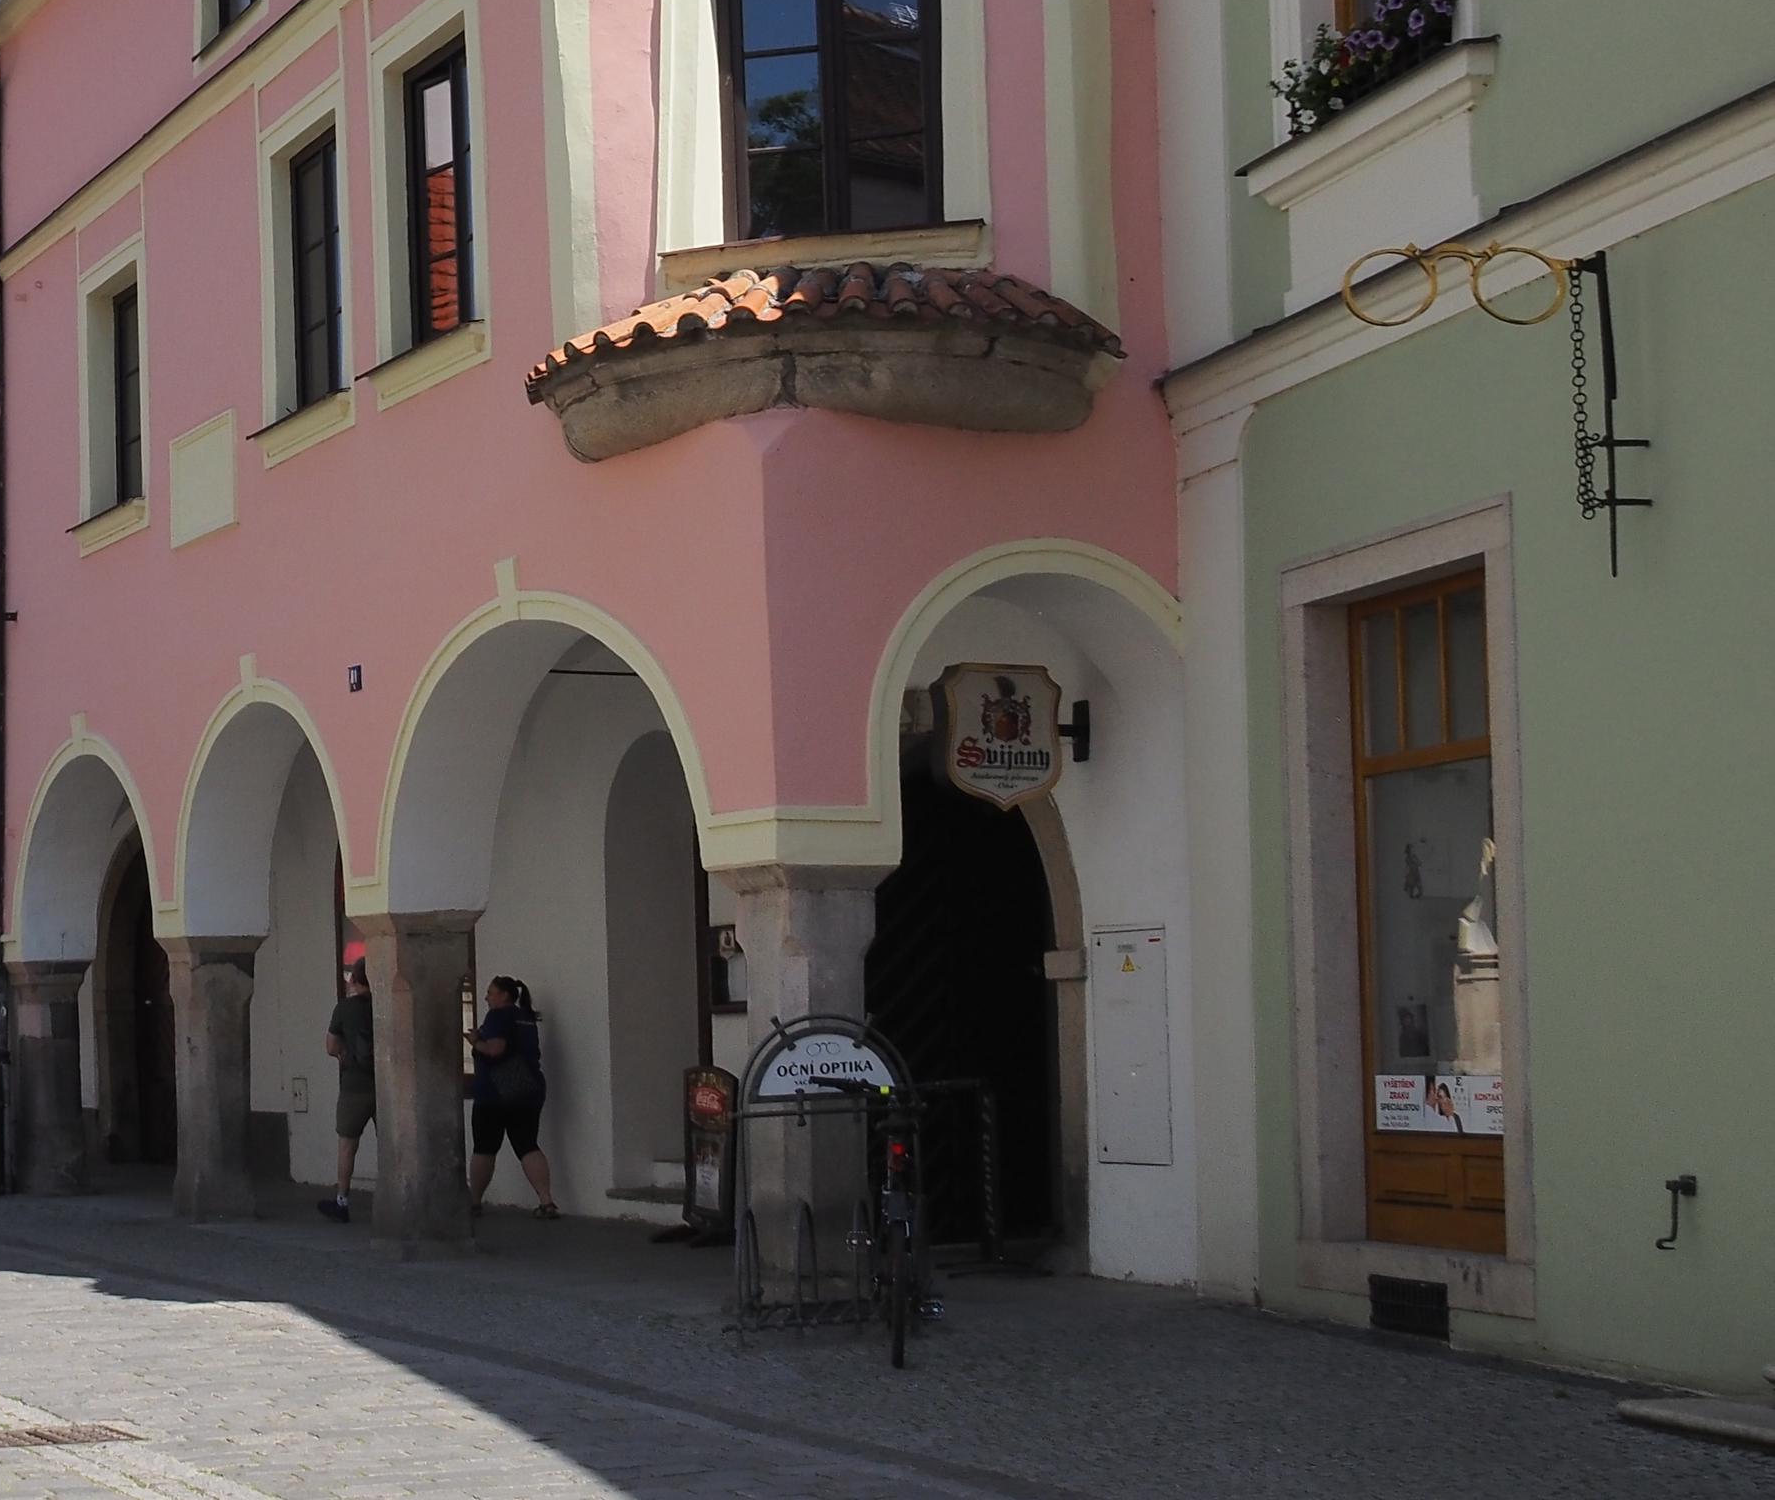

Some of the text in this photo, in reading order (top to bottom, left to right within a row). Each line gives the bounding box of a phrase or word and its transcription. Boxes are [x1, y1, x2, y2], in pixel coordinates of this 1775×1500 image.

[957, 737, 1049, 770] Svijany
[777, 1060, 873, 1077] OČNÍ OPTIKA
